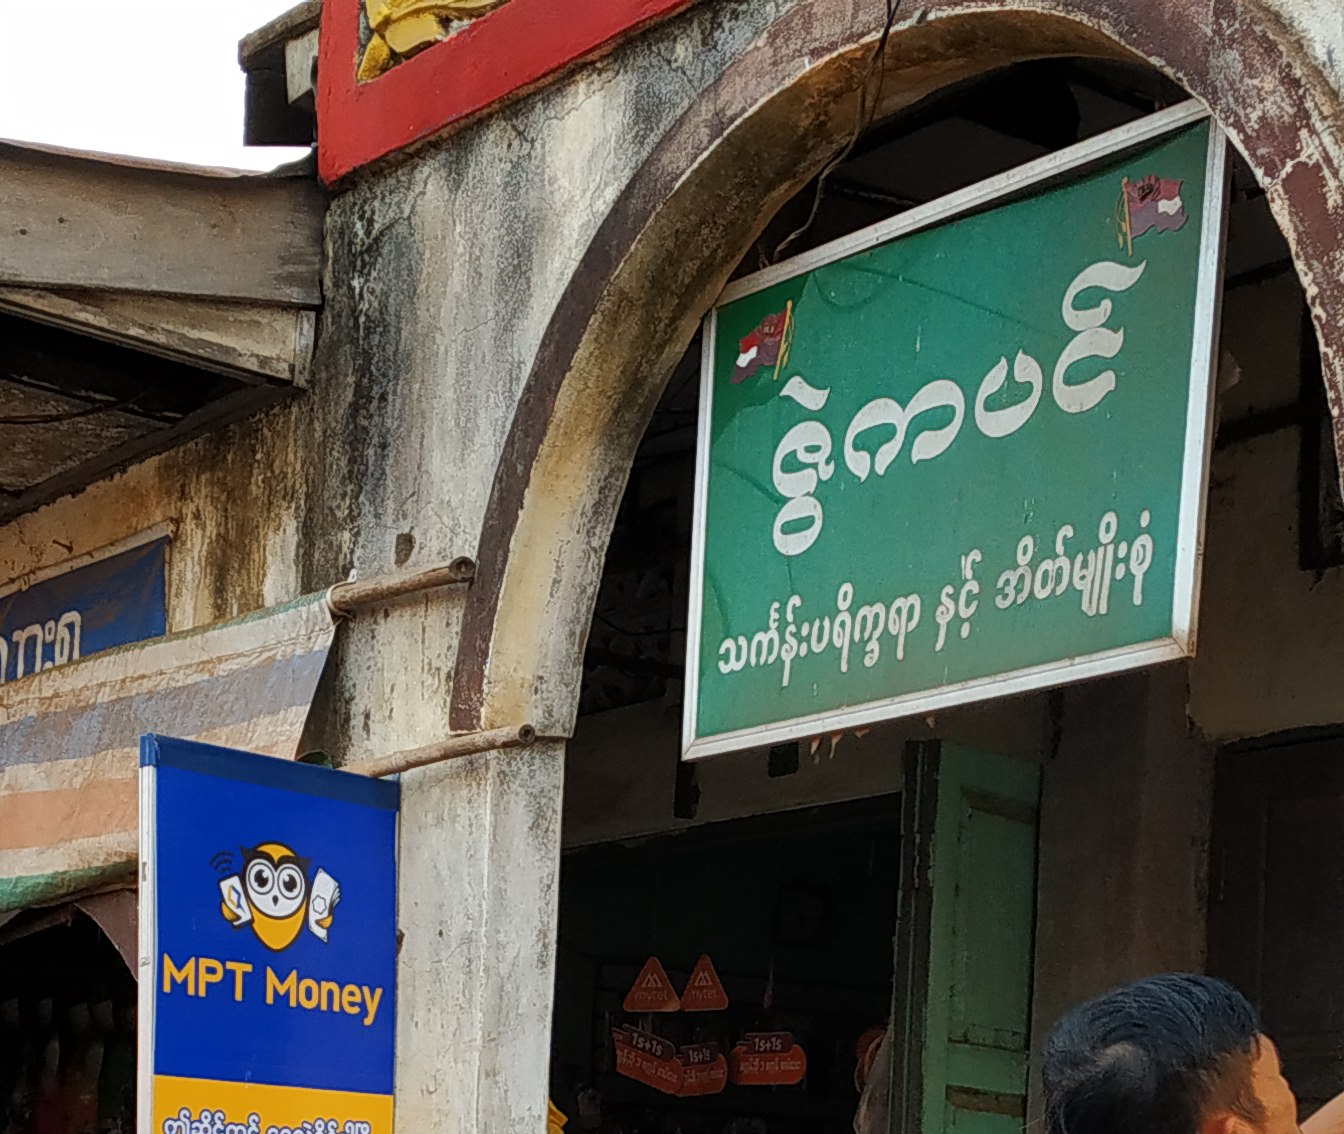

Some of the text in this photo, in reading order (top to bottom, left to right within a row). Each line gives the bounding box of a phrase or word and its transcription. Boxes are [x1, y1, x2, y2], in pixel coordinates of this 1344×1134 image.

[771, 258, 1148, 557] ဇွဲကပင်
[934, 546, 983, 653] နှင့်
[994, 507, 1155, 617] အိတ်မျိုးစုံ
[161, 951, 384, 1028] MPT Money
